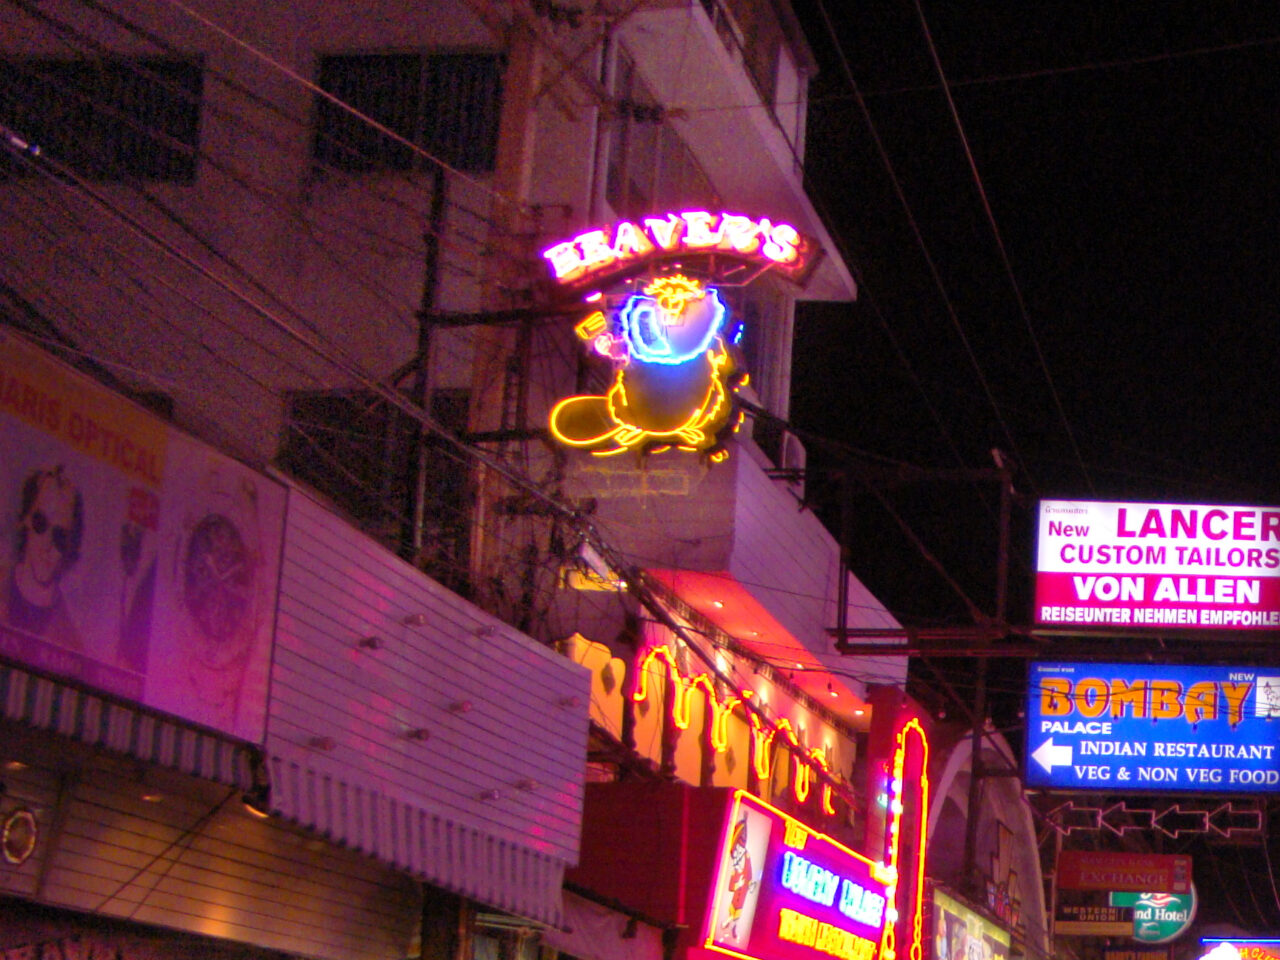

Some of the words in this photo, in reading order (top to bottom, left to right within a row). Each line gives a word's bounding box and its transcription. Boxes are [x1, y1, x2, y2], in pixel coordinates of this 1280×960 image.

[543, 211, 800, 278] BEAVER'S
[0, 371, 60, 432] ARIS
[68, 411, 161, 484] OPTICAL
[1048, 520, 1089, 537] New
[1060, 543, 1166, 565] CUSTOM
[1175, 546, 1280, 569] TAILORS
[1073, 576, 1145, 601] VON
[1153, 577, 1260, 604] ALLEN
[1041, 606, 1131, 623] REISEUNTER
[1133, 608, 1197, 624] NEHMEN
[1228, 672, 1254, 682] NEW
[1040, 677, 1254, 726] BOMBAY
[1041, 720, 1112, 735] PALACE
[1080, 740, 1147, 757] INDIAN
[1153, 743, 1275, 760] RESTAURANT
[1074, 766, 1111, 780] VEG
[1116, 767, 1131, 781] &
[1137, 767, 1178, 782] NON
[1185, 768, 1222, 783] VEG
[1229, 769, 1280, 785] FOOD
[1080, 871, 1168, 884] EXCHANGE
[1063, 906, 1116, 914] WESTERN
[1155, 909, 1188, 922] Hotel
